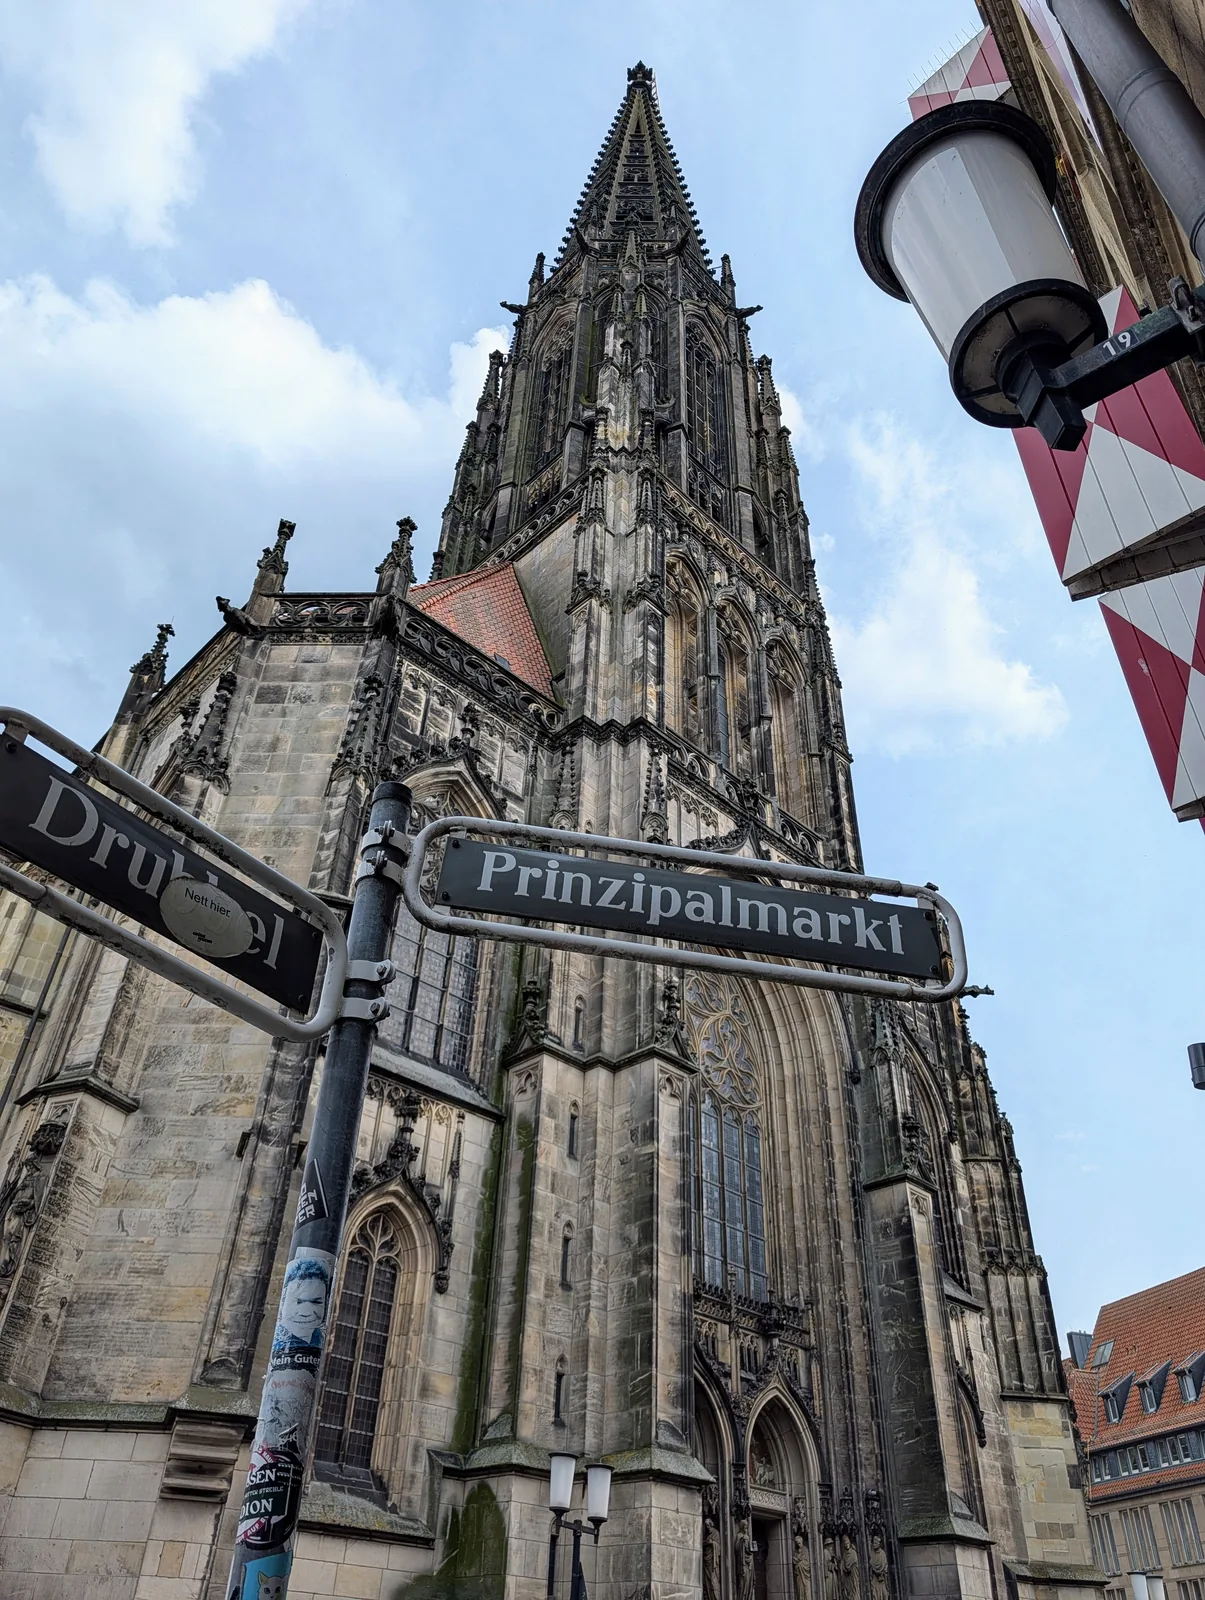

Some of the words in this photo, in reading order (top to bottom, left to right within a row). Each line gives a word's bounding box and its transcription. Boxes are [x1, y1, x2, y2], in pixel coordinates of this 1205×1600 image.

[1102, 332, 1131, 356] 19
[28, 774, 285, 971] Druel
[184, 887, 208, 907] Nett
[475, 850, 905, 956] Prinzipalmarkt
